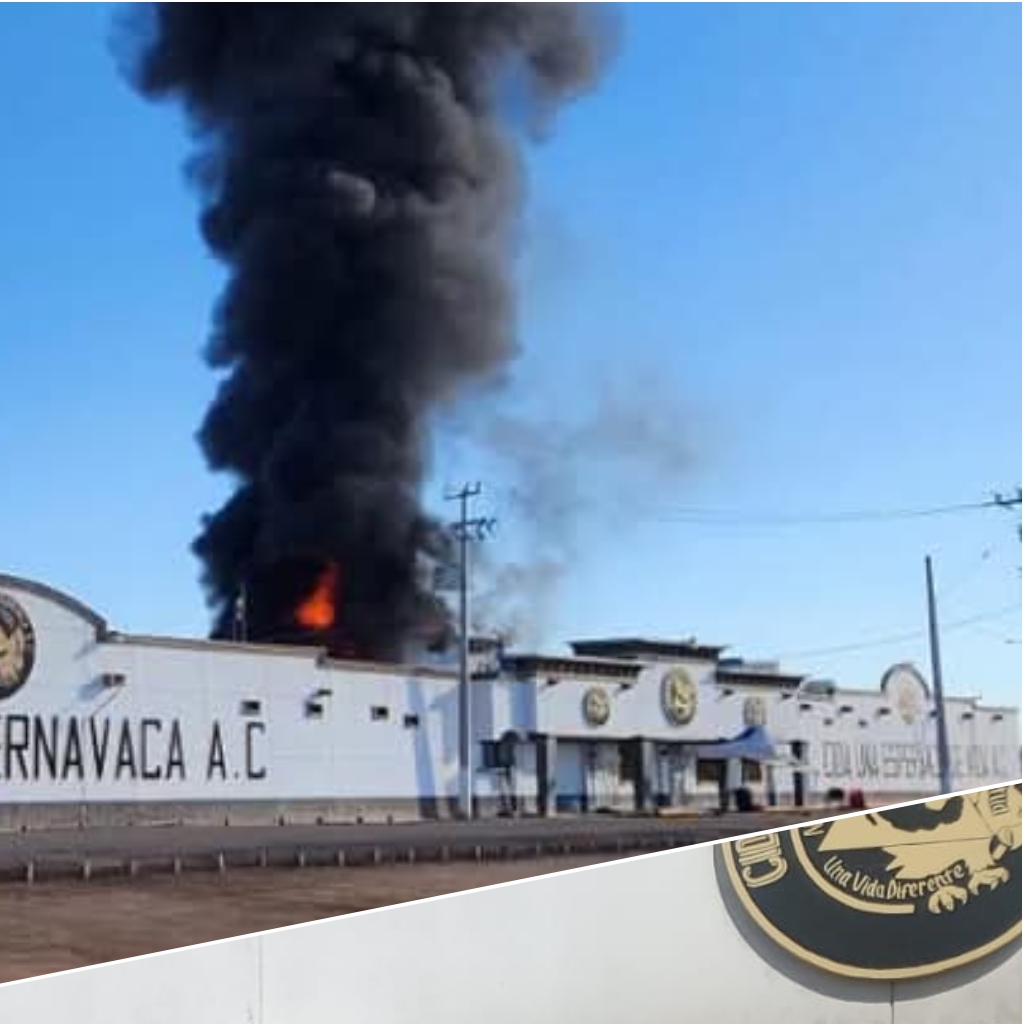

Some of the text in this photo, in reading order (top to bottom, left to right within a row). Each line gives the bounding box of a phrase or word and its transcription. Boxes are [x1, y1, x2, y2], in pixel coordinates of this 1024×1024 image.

[207, 718, 267, 780] A.C
[823, 855, 852, 887] Una
[852, 870, 885, 898] Vida
